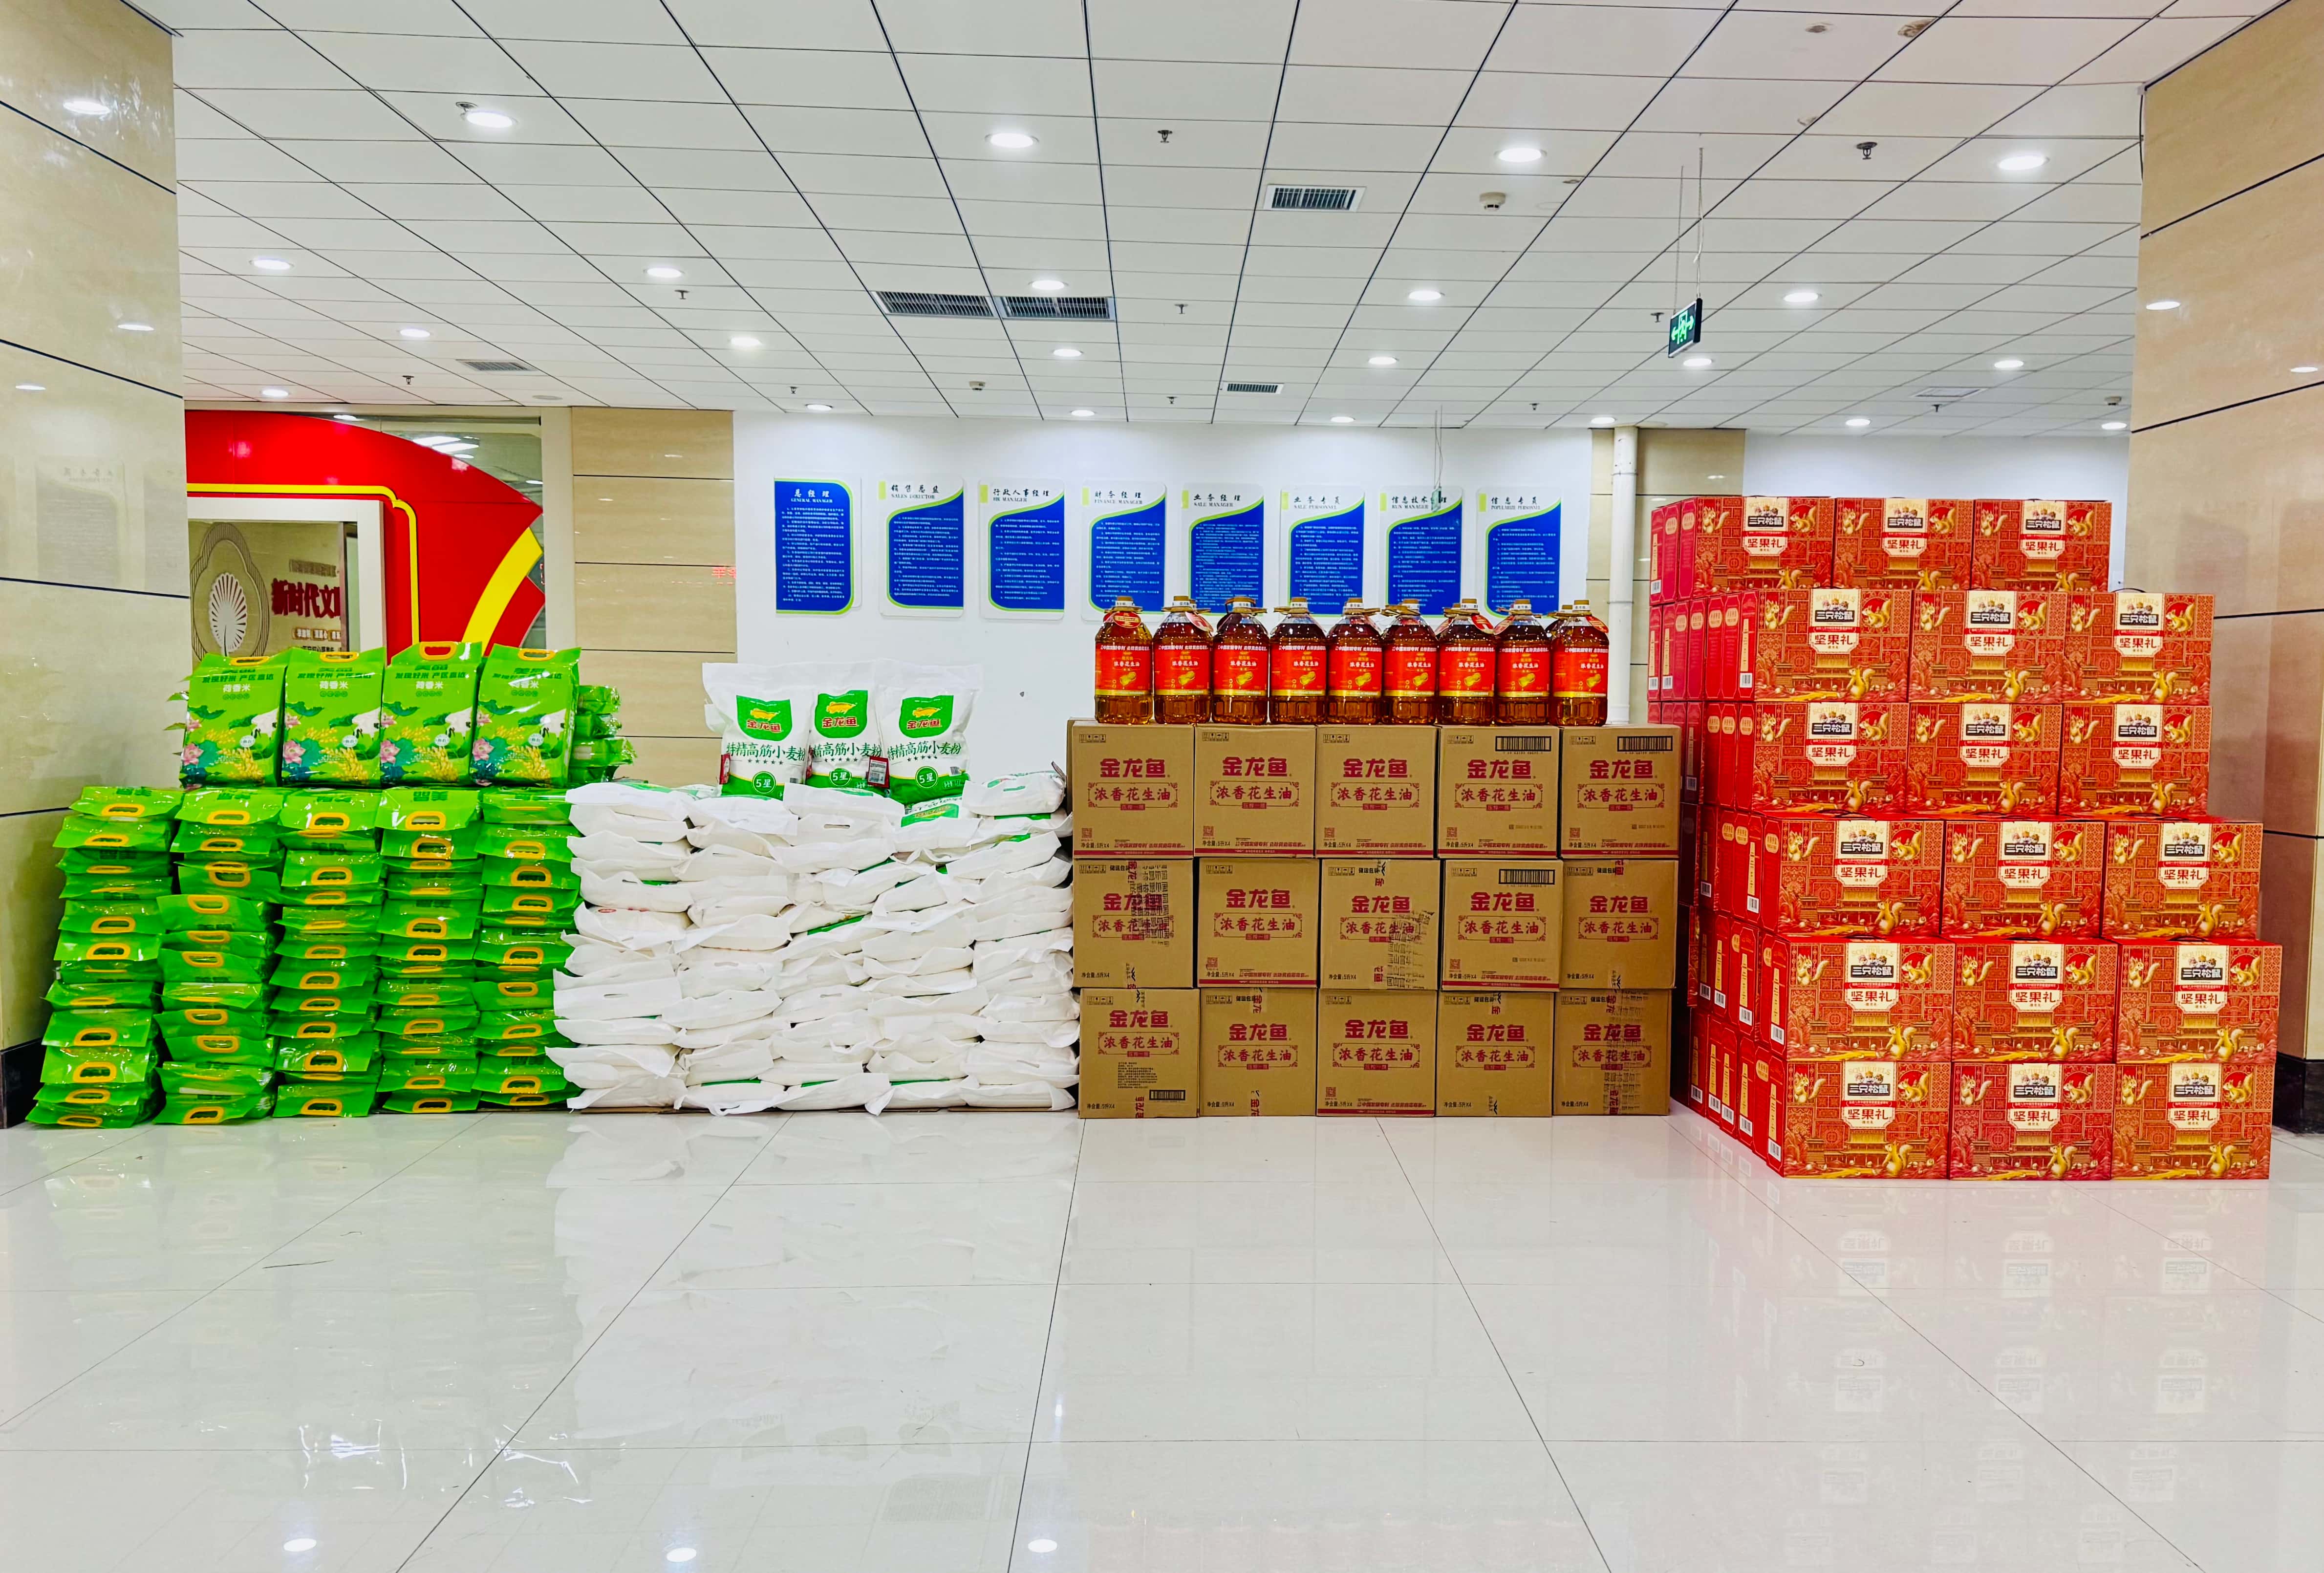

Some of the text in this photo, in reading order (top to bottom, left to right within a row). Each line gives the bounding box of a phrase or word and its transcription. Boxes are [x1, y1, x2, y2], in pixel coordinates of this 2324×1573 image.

[794, 488, 830, 497] 总经理
[993, 488, 1050, 497] 行政人事经理
[1095, 490, 1141, 499] 财务经理
[1193, 493, 1241, 501] 业务经理
[1293, 496, 1340, 504] 业务专员
[1392, 496, 1447, 504] 信息技术理
[1491, 496, 1537, 505] 信息专员
[2027, 520, 2060, 529] 三只松鼠
[1747, 538, 1783, 548] 坚果礼
[1887, 539, 1922, 549] 坚果礼
[2025, 541, 2060, 551] 坚果礼
[1816, 611, 1853, 620] 三只松鼠
[1972, 613, 2009, 622] 三只松鼠
[2121, 615, 2157, 624] 三只松鼠
[1815, 634, 1852, 645] 坚果礼
[1970, 636, 2008, 647] 坚果礼
[2120, 638, 2157, 648] 坚果礼
[223, 684, 251, 692] 荷香米
[319, 681, 348, 689] 荷香米
[416, 681, 444, 689] 荷香米
[746, 719, 782, 733] 金龙鱼
[822, 716, 857, 728] 金龙鱼
[907, 719, 941, 730] 金龙鱼
[1813, 724, 1851, 733] 三只松鼠
[1967, 725, 2004, 734] 三只松鼠
[2120, 727, 2155, 735] 三只松鼠
[726, 742, 806, 761] 特精高筋小麦粉
[813, 742, 882, 757] 精高筋小麦粉
[887, 741, 962, 761] 特精高筋小麦粉
[1811, 747, 1851, 757] 坚果礼
[1966, 748, 2003, 759] 坚果礼
[2118, 750, 2155, 760] 坚果礼
[1100, 758, 1165, 778] 金龙鱼
[1223, 756, 1287, 777] 金龙鱼
[1344, 758, 1408, 778] 金龙鱼
[1467, 759, 1531, 779] 金龙鱼
[1590, 759, 1654, 779] 金龙鱼
[833, 772, 849, 781] 5星
[919, 772, 935, 784] 5星
[756, 779, 772, 788] 5星
[1095, 787, 1171, 801] 浓香花生油
[1216, 786, 1292, 800] 浓香花生油
[1337, 787, 1412, 801] 浓香花生油
[1461, 788, 1536, 802] 浓香花生油
[1583, 788, 1658, 802] 浓香花生油
[1842, 843, 1881, 852] 三只松鼠
[2006, 844, 2044, 853] 三只松鼠
[2166, 845, 2203, 854] 三只松鼠
[1128, 861, 1137, 883] 金龙
[1841, 867, 1881, 878] 坚果礼
[2004, 868, 2044, 879] 坚果礼
[2164, 869, 2203, 880] 坚果礼
[1227, 889, 1290, 909] 金龙鱼
[1352, 895, 1410, 914] 金龙鱼
[1471, 891, 1534, 912] 金龙鱼
[1590, 895, 1648, 913] 金龙鱼
[1220, 918, 1295, 931] 浓香花生油
[1346, 922, 1415, 934] 浓香花生油
[1464, 921, 1539, 934] 浓香花生油
[1584, 922, 1652, 934] 浓香花生油
[1852, 966, 1892, 975] 三只松鼠
[2017, 967, 2056, 976] 三只松鼠
[2183, 969, 2221, 978] 三只松鼠
[1851, 991, 1892, 1002] 坚果礼
[2016, 991, 2056, 1003] 坚果礼
[2181, 993, 2220, 1004] 坚果礼
[1110, 1010, 1168, 1028] 金龙鱼
[1229, 1024, 1288, 1041] 金龙鱼
[1345, 1019, 1408, 1039] 金龙鱼
[1467, 1024, 1525, 1042] 金龙鱼
[1584, 1023, 1642, 1043] 金龙鱼
[1104, 1036, 1173, 1049] 浓香花生油
[1223, 1049, 1291, 1061] 浓香花生油
[1339, 1048, 1413, 1061] 浓香花生油
[1461, 1050, 1528, 1062] 浓香花生油
[1578, 1049, 1645, 1062] 浓香花生油
[1849, 1084, 1889, 1094] 三只松鼠
[2015, 1086, 2054, 1096] 三只松鼠
[2175, 1086, 2214, 1095] 三只松鼠
[1848, 1109, 1889, 1120] 坚果礼
[2014, 1110, 2053, 1121] 坚果礼
[2173, 1110, 2213, 1120] 坚果礼
